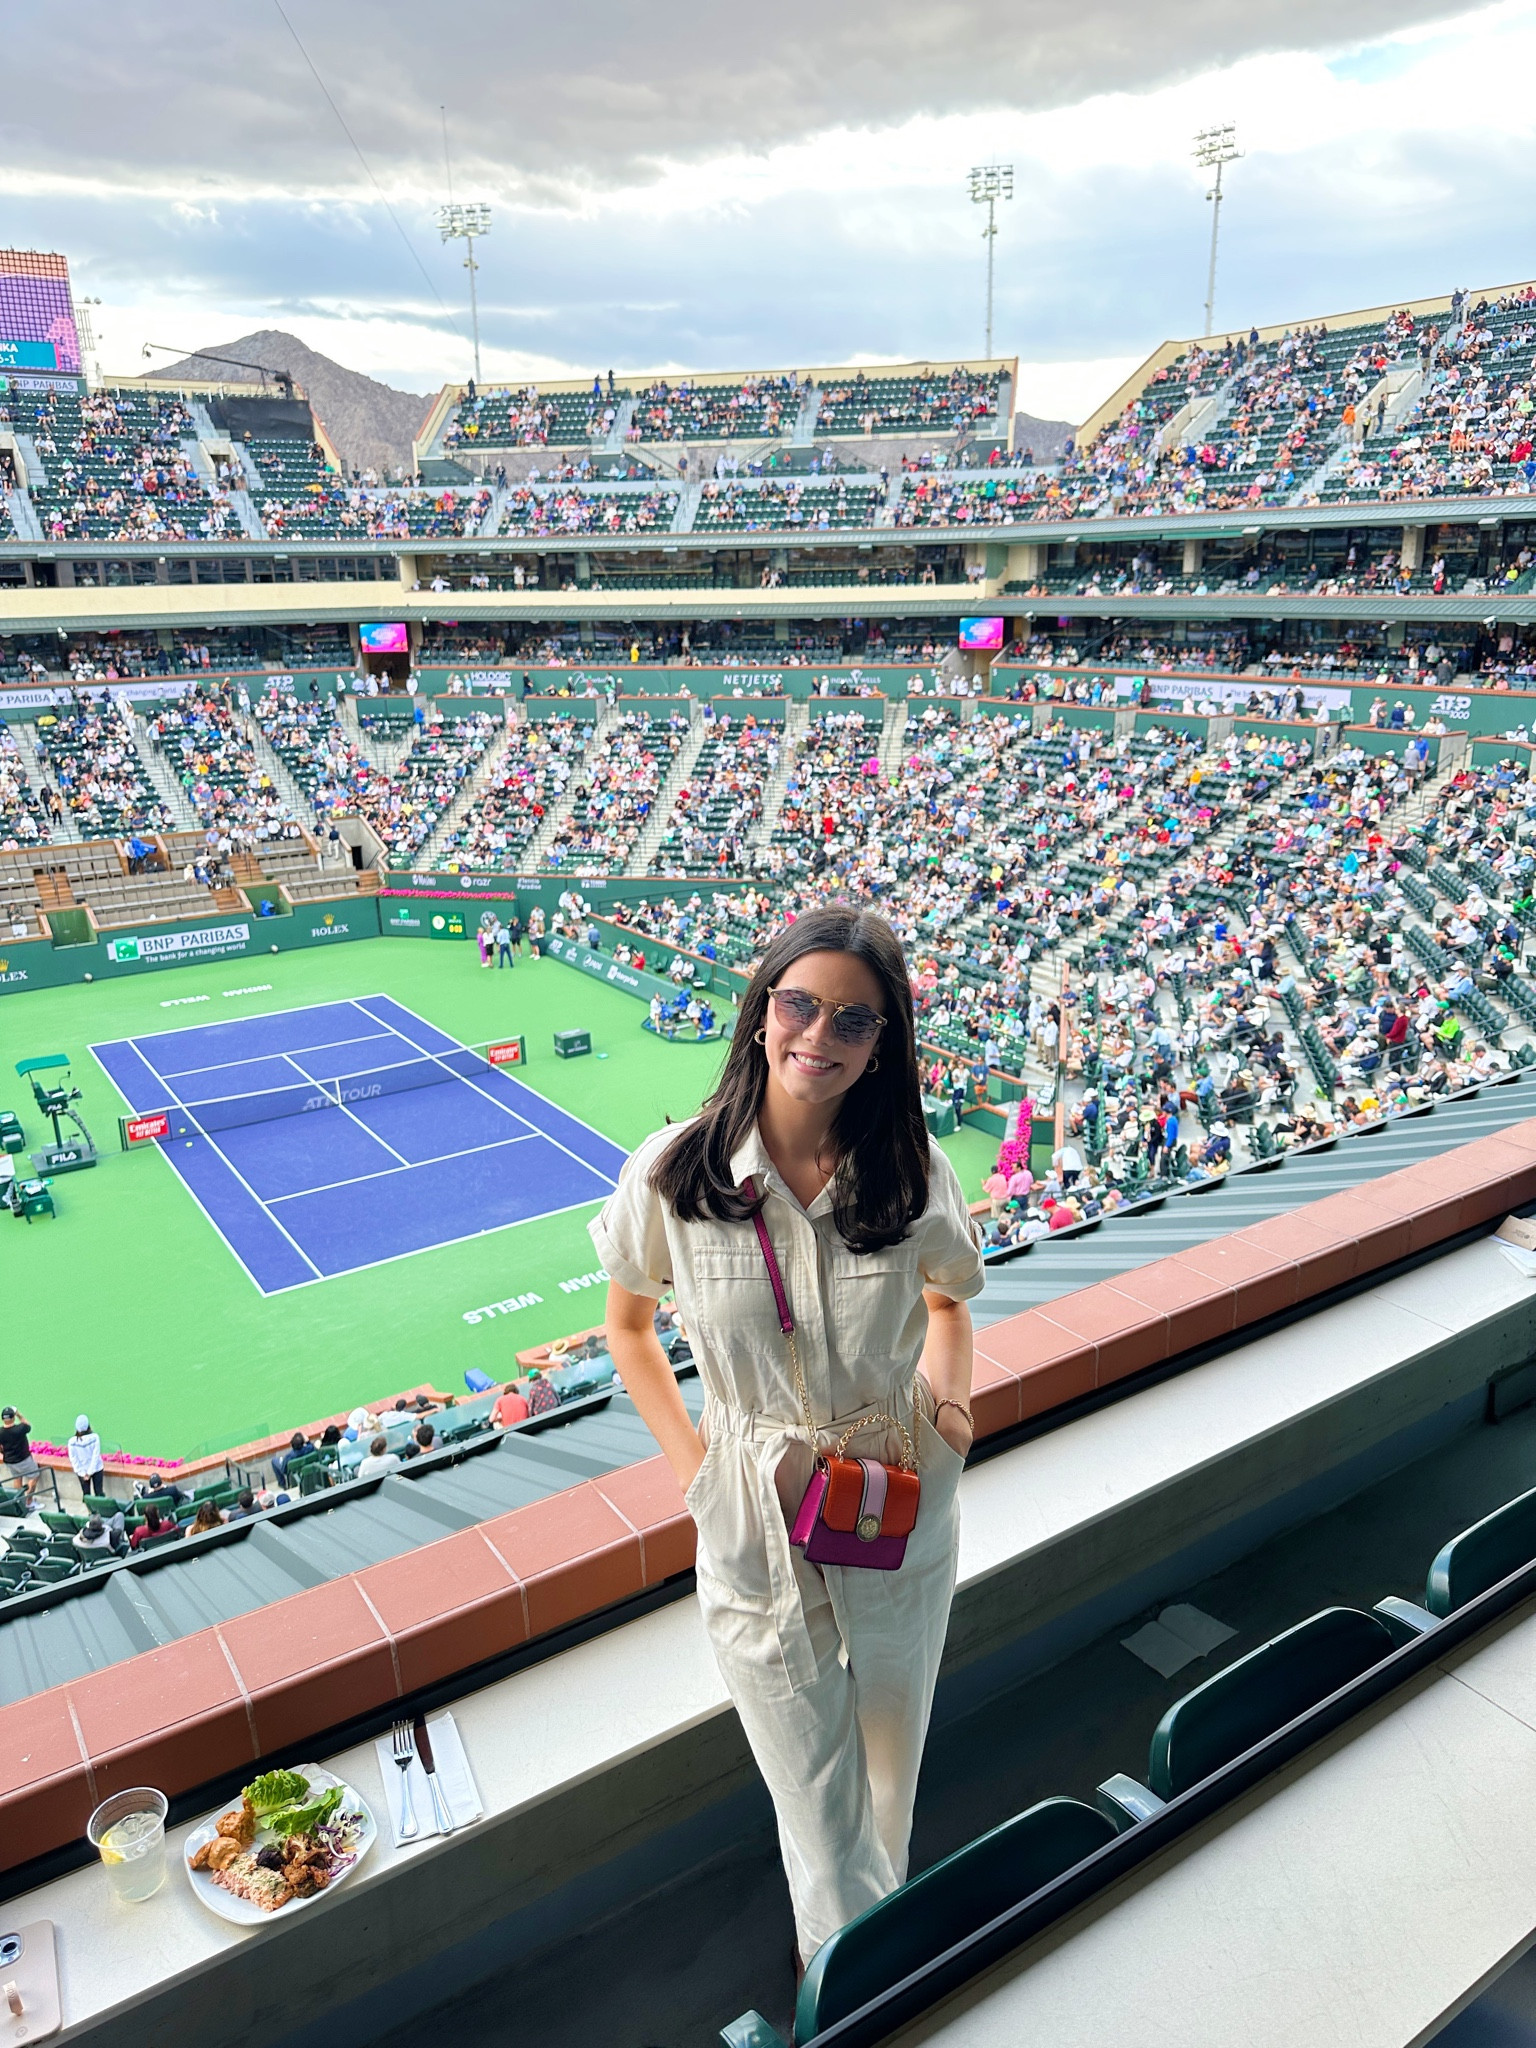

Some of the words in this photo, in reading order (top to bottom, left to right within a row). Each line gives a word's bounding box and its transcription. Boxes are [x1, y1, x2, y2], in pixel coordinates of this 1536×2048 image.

[0, 343, 18, 353] KA
[470, 671, 512, 681] HOLOGIC
[723, 674, 776, 687] NETJETS
[1171, 685, 1214, 697] PARIBAS
[6, 694, 51, 704] PARIBA
[1430, 695, 1471, 711] ATP
[311, 924, 349, 937] ROLEX
[143, 938, 174, 952] BNP
[180, 926, 243, 947] PARIBAS
[145, 955, 158, 963] The
[195, 946, 226, 956] changing
[226, 942, 246, 951] world
[0, 970, 28, 983] LEX
[341, 1083, 382, 1103] TOUR
[47, 1103, 63, 1111] FILA
[129, 1117, 166, 1134] Emirates
[51, 1151, 77, 1164] FILA
[558, 1269, 611, 1294] DIAN
[462, 1292, 544, 1325] WELLS
